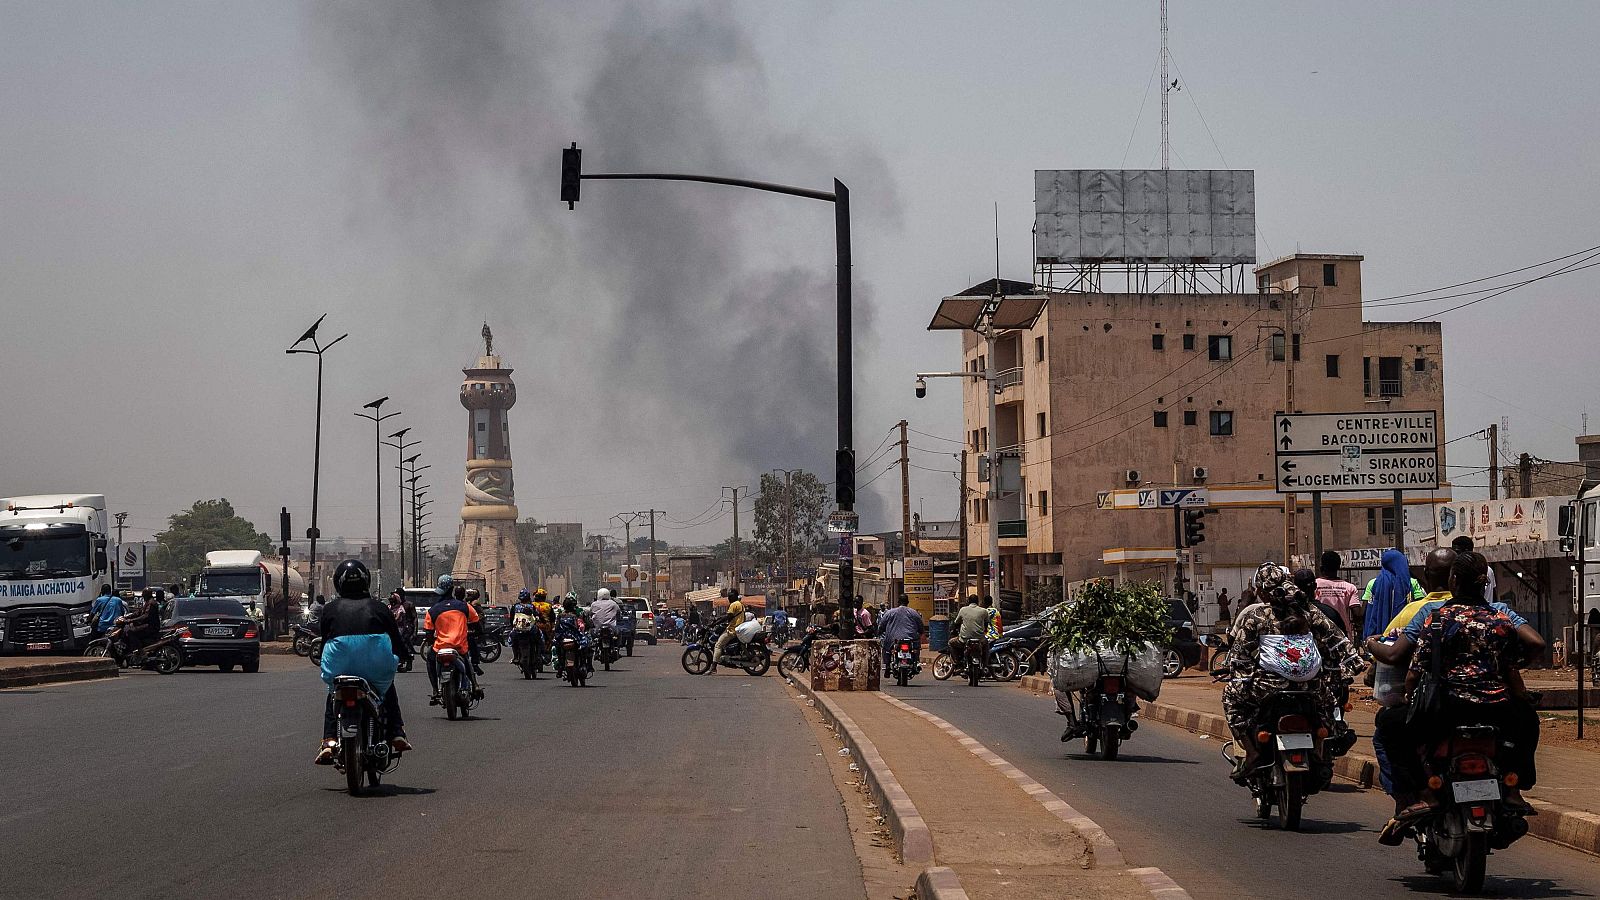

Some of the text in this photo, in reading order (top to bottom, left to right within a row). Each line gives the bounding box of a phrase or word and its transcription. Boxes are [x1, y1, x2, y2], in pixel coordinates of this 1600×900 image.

[1336, 417, 1433, 431] CENTRE-VILLE
[1321, 432, 1434, 446] BACODJICORONI
[1369, 457, 1435, 470] SIRAKORO
[1297, 471, 1436, 487] LOGEMENTS SOCIAUX
[1351, 548, 1387, 561] DEN
[913, 559, 929, 567] BMS
[10, 583, 35, 597] MAIGA
[37, 581, 76, 596] AICHATOU
[76, 581, 85, 591] 4
